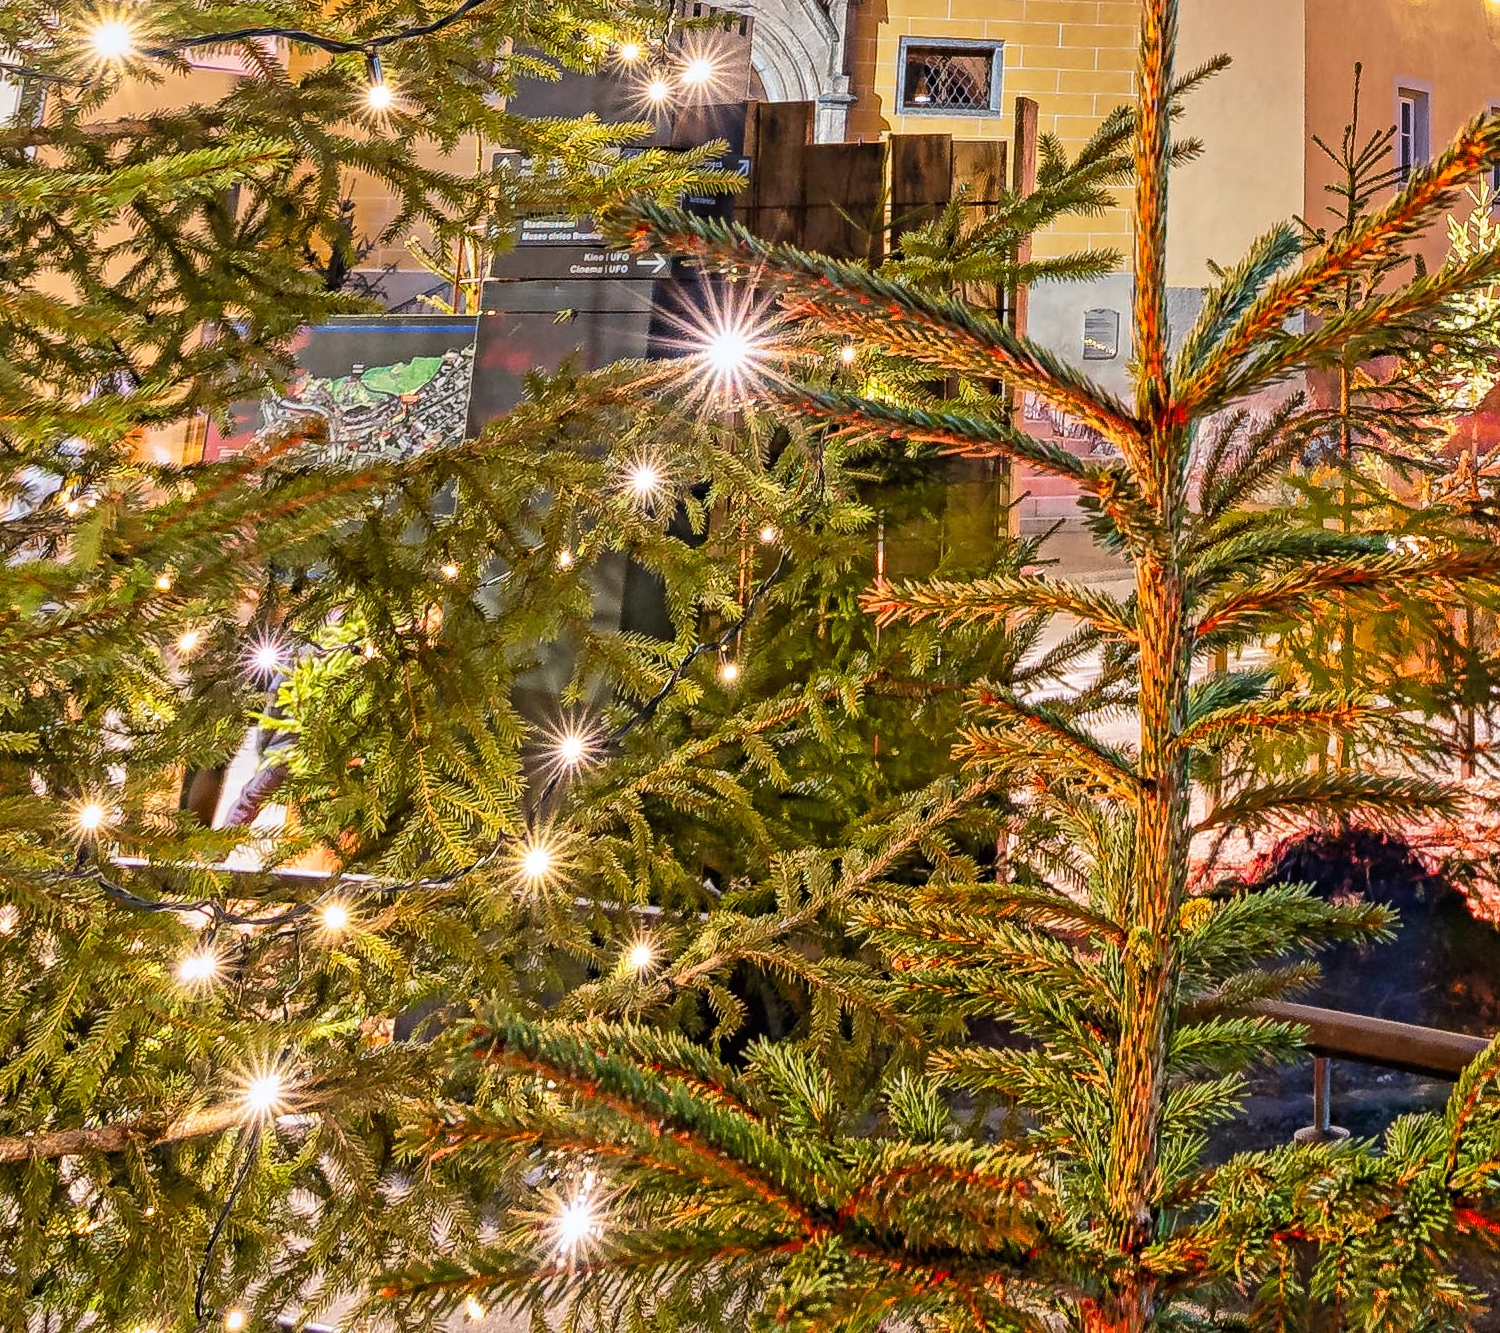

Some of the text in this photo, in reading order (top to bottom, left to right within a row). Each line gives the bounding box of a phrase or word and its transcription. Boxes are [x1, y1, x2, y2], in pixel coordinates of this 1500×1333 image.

[521, 231, 547, 241] Museo
[584, 252, 604, 262] Kino
[610, 252, 630, 262] UFO
[570, 264, 603, 274] Cinema
[608, 264, 629, 274] UFO
